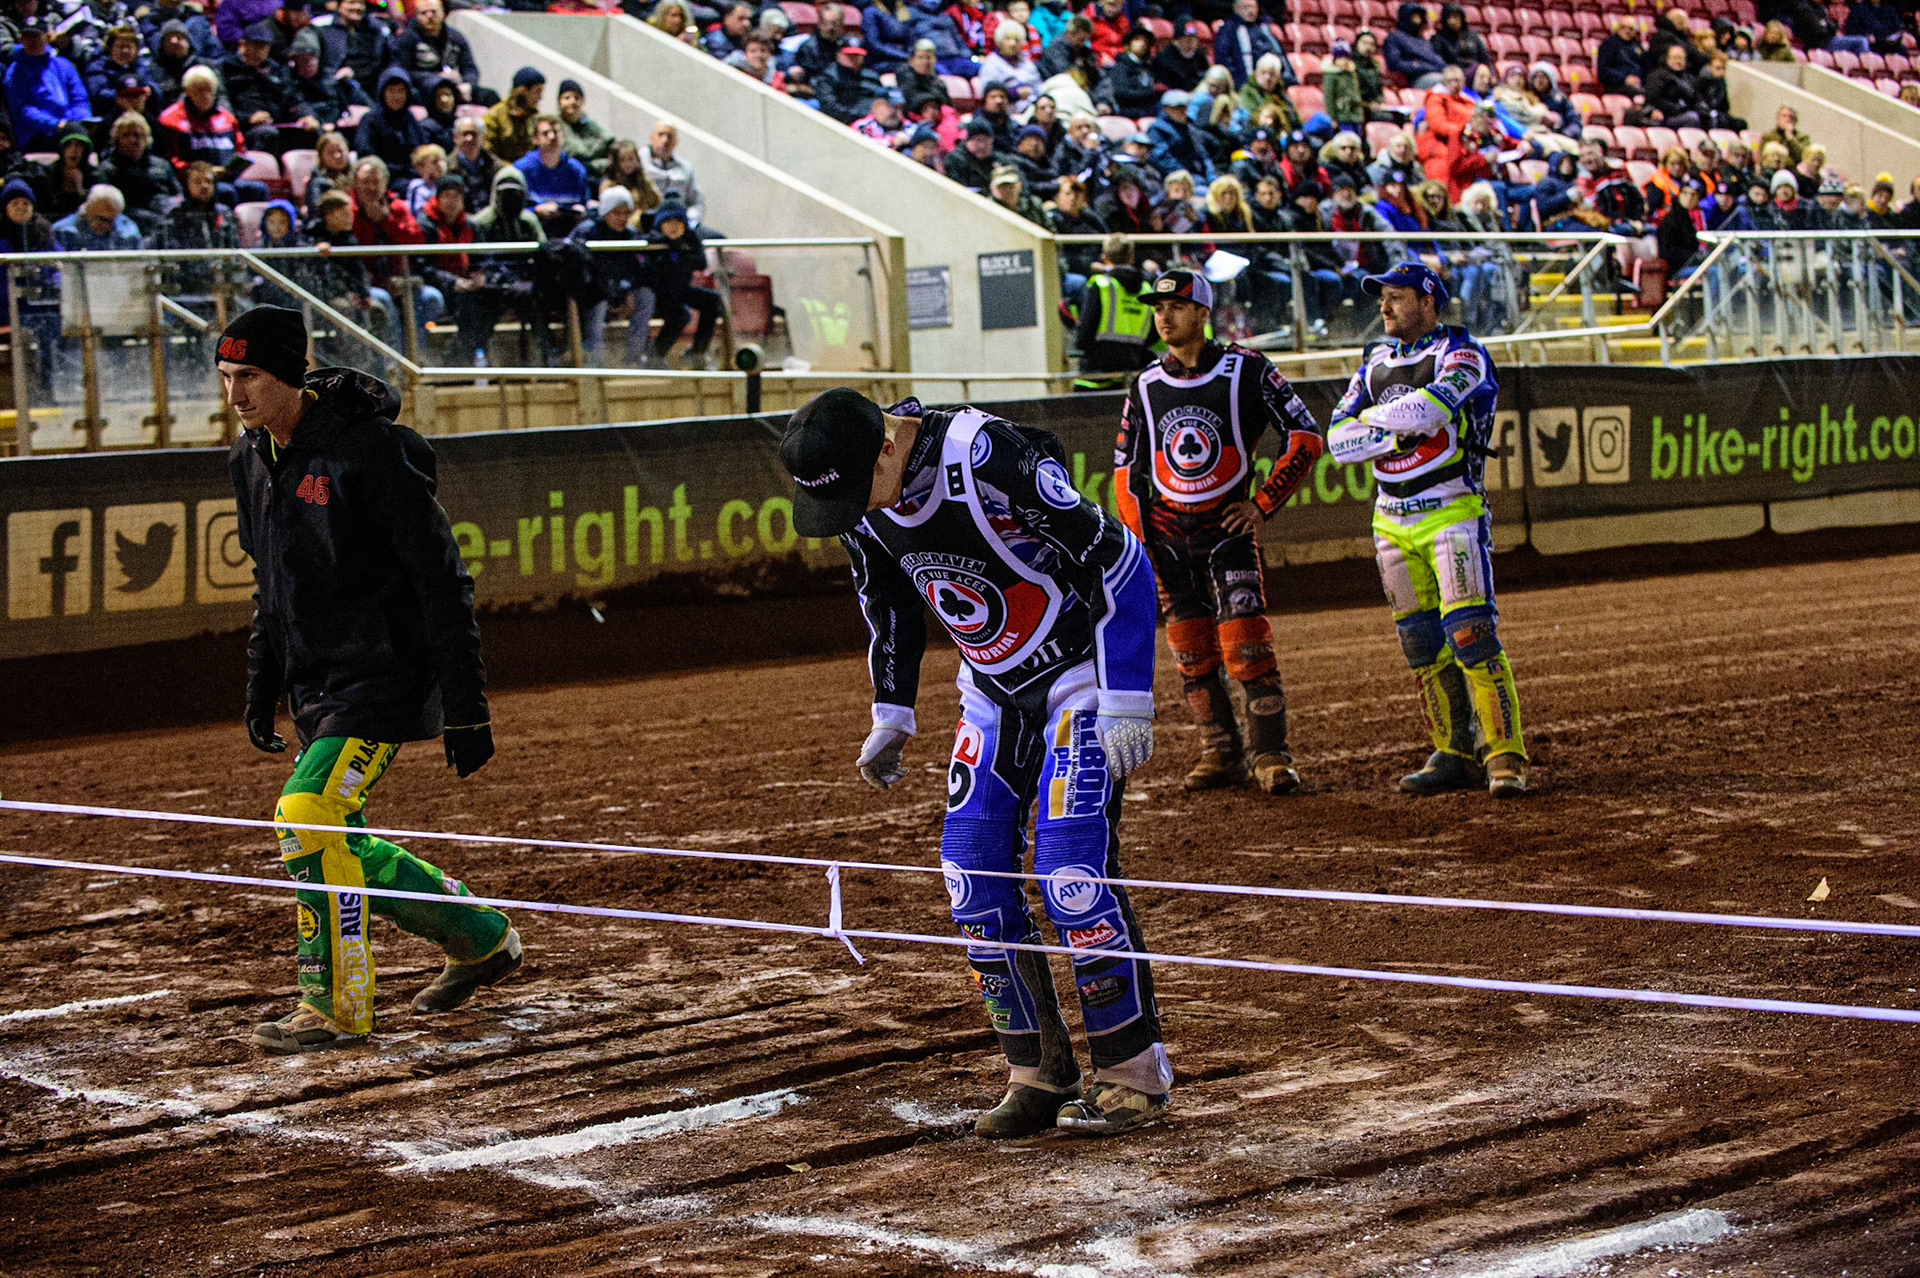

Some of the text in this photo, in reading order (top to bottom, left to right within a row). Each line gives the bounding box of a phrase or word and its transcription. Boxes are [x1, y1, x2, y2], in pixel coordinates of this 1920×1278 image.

[217, 337, 248, 360] 46
[1454, 352, 1479, 360] NGK
[1182, 420, 1198, 428] VUE
[1200, 425, 1216, 441] ACES
[1650, 403, 1920, 484] bike-right.co
[1264, 444, 1313, 498] BORGE
[296, 474, 330, 506] 46
[1169, 474, 1218, 491] MEMORIAL
[1380, 498, 1442, 516] HARRIS
[452, 483, 838, 588] e-right.co
[920, 552, 987, 574] CRAVEN
[928, 571, 950, 580] VUE
[955, 575, 987, 593] ACES
[1072, 709, 1082, 753] ENGINEERING
[1054, 746, 1072, 778] plc
[1073, 709, 1107, 816] ALBON
[1065, 761, 1079, 816] MANUFACTURING
[1059, 881, 1091, 902] ATPI
[1069, 922, 1111, 943] NGK
[1095, 930, 1115, 945] PLUGS
[995, 1012, 1010, 1022] OIL
